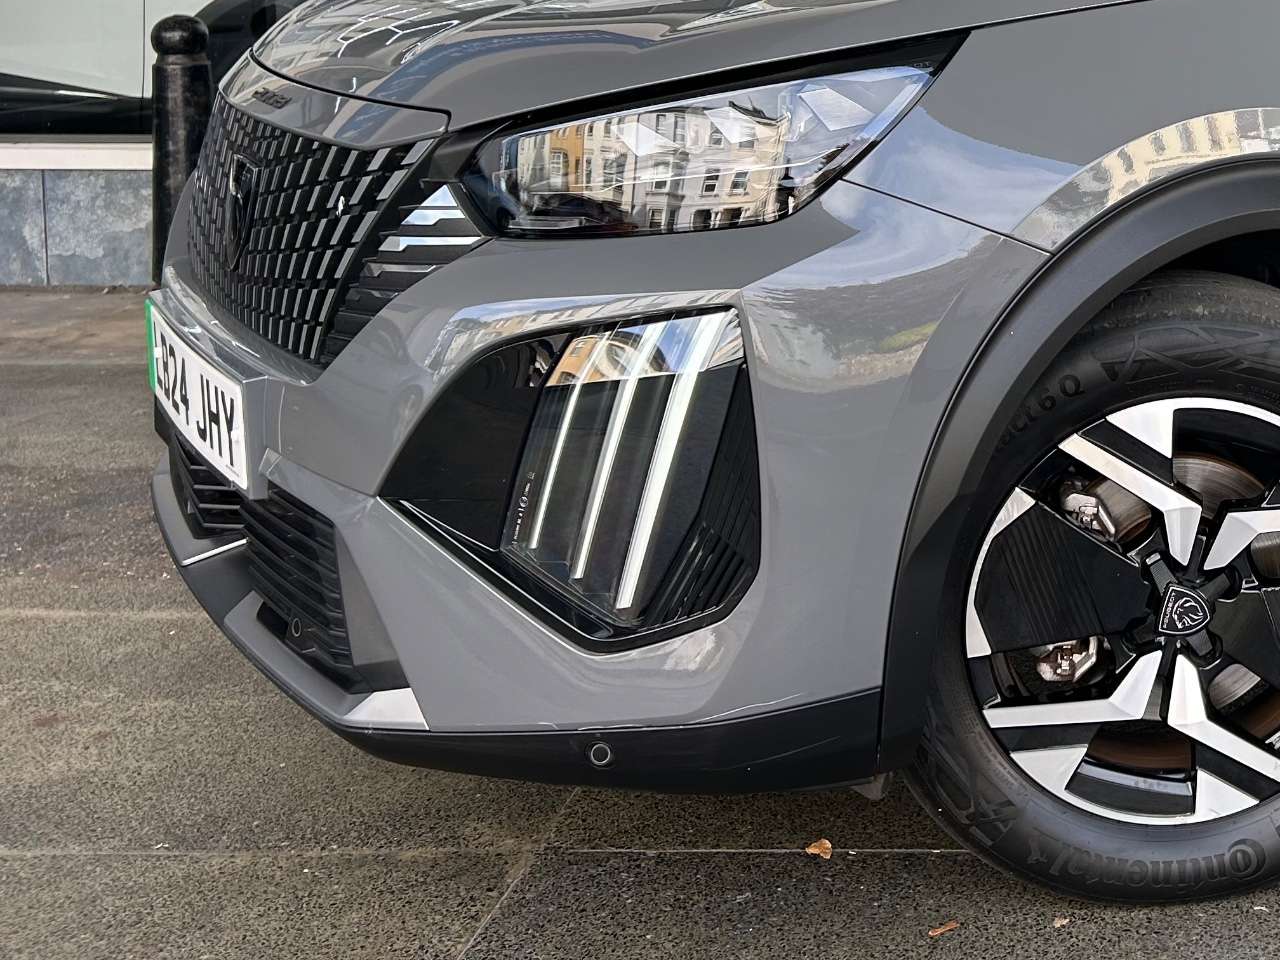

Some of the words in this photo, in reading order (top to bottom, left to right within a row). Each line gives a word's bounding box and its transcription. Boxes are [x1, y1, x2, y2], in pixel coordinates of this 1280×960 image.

[153, 322, 190, 426] LB24
[196, 373, 235, 467] JHY
[1048, 837, 1267, 894] Continental
